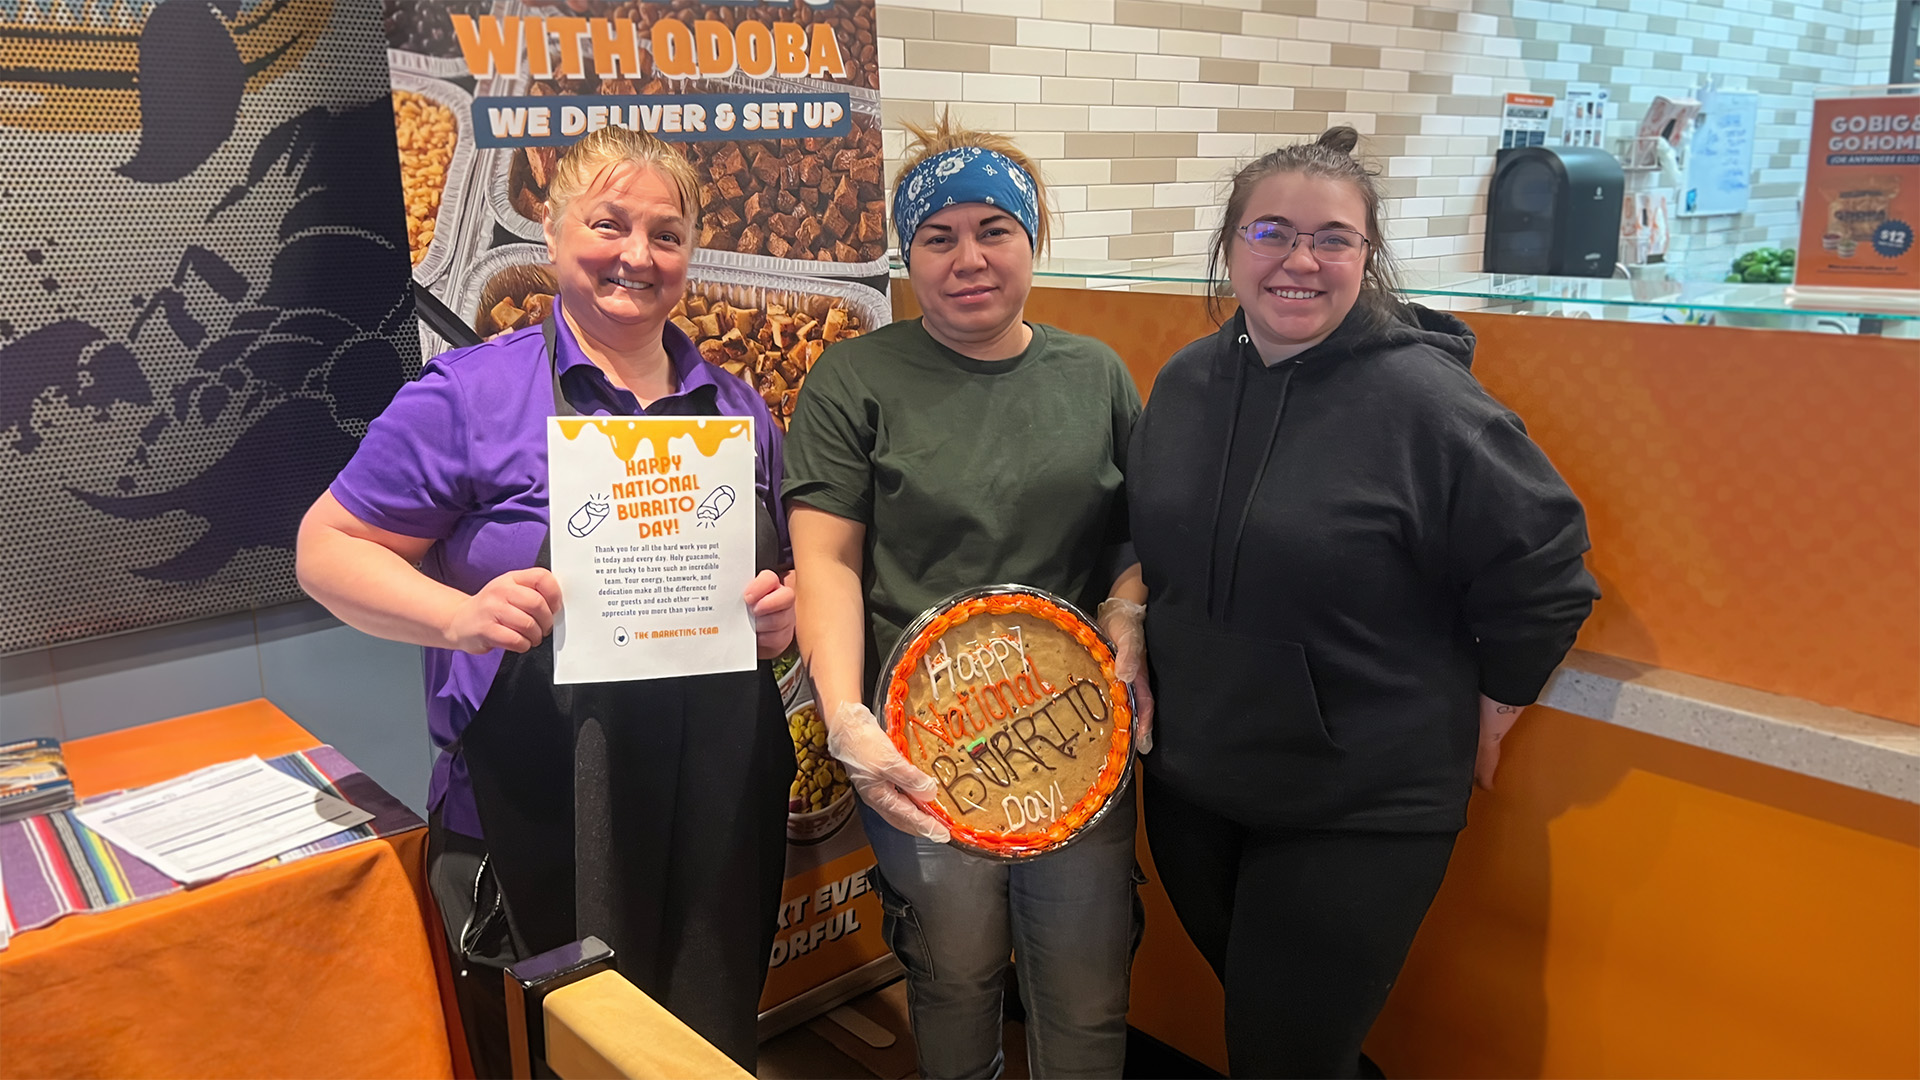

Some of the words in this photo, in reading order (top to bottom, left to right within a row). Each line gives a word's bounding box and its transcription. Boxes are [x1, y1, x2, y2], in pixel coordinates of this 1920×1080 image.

[451, 14, 642, 79] WITH
[650, 19, 848, 79] QDOBA
[487, 105, 551, 138] WE
[561, 103, 707, 136] DELIVER
[715, 103, 736, 131] &
[742, 102, 798, 132] SET
[803, 101, 845, 129] UP
[1828, 135, 1861, 152] GO
[1880, 229, 1907, 244] $12
[625, 455, 682, 477] HAPPY
[612, 474, 700, 499] NATIONAL
[617, 496, 695, 521] BURRITO
[638, 518, 680, 539] DAY!
[595, 545, 615, 553] Thank
[641, 544, 649, 552] all
[709, 542, 719, 550] put
[594, 556, 601, 564] in
[602, 556, 620, 564] today
[636, 555, 653, 563] every
[670, 554, 684, 562] Holy
[618, 566, 636, 574] lucky
[646, 565, 661, 573] have
[663, 564, 678, 572] such
[688, 562, 719, 570] incredible
[700, 573, 711, 581] and
[598, 588, 633, 596] dedication
[653, 586, 662, 594] all
[675, 584, 707, 593] difference
[708, 583, 717, 591] for
[620, 598, 642, 607] guests
[643, 597, 655, 605] and
[657, 596, 672, 604] each
[673, 595, 690, 603] other
[601, 609, 636, 618] appreciate
[638, 609, 649, 617] you
[669, 606, 683, 614] than
[685, 606, 696, 614] you
[634, 630, 649, 640] THE
[651, 628, 697, 639] MARKETING
[699, 626, 719, 636] TEAM
[924, 626, 1029, 700] Happy
[908, 655, 1056, 760] National
[931, 676, 1109, 815] BURRITO
[1000, 781, 1068, 835] Day!
[814, 865, 878, 914] EVE
[769, 907, 861, 968] ORFUL
